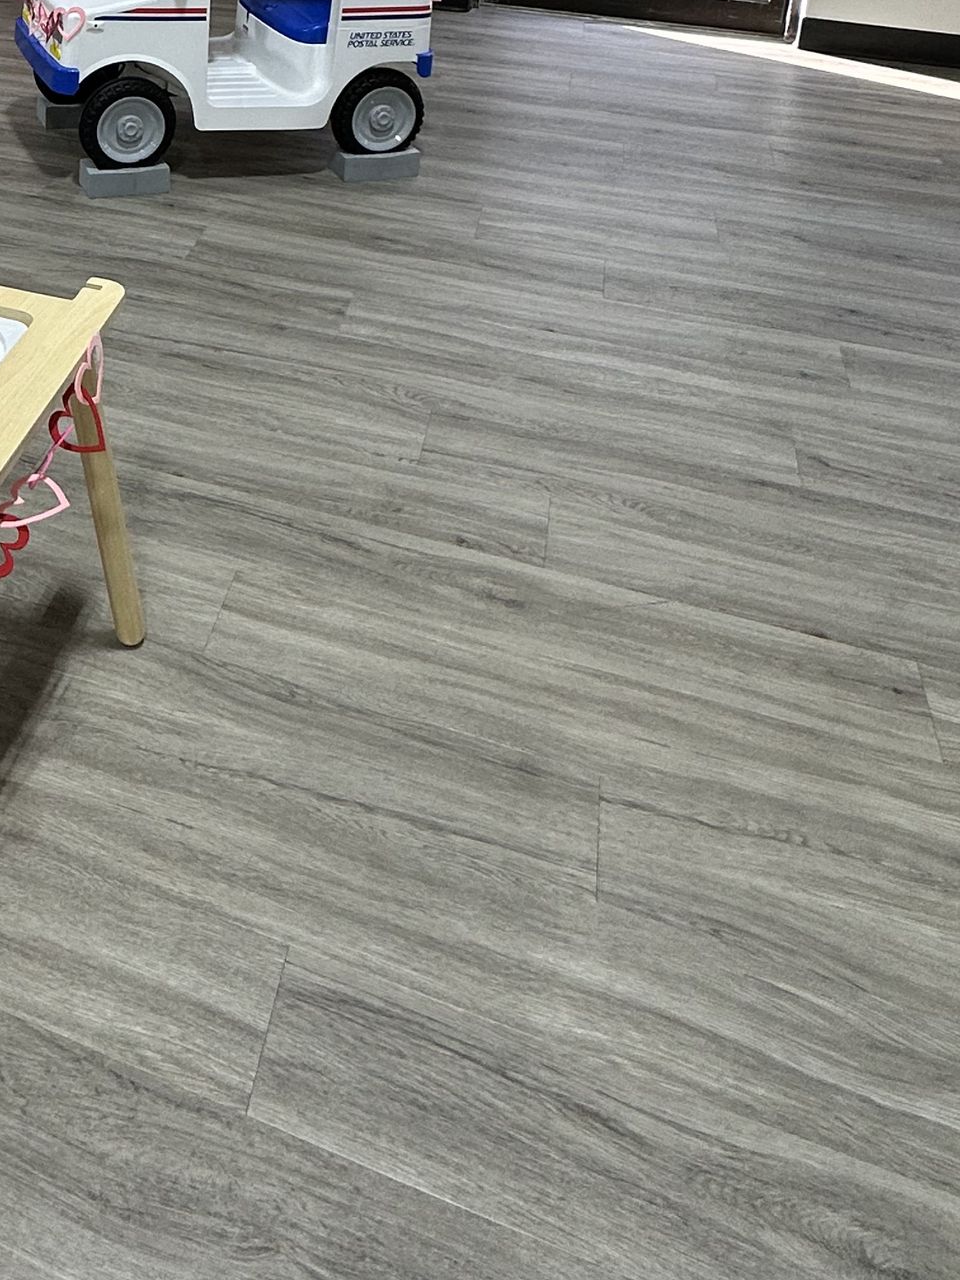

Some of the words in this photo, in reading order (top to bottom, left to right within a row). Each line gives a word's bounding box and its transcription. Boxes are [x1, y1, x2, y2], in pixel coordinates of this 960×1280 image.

[349, 31, 383, 40] UNITED
[383, 30, 414, 39] STATES
[347, 39, 378, 48] POSTAL
[380, 38, 415, 47] SERVICE
